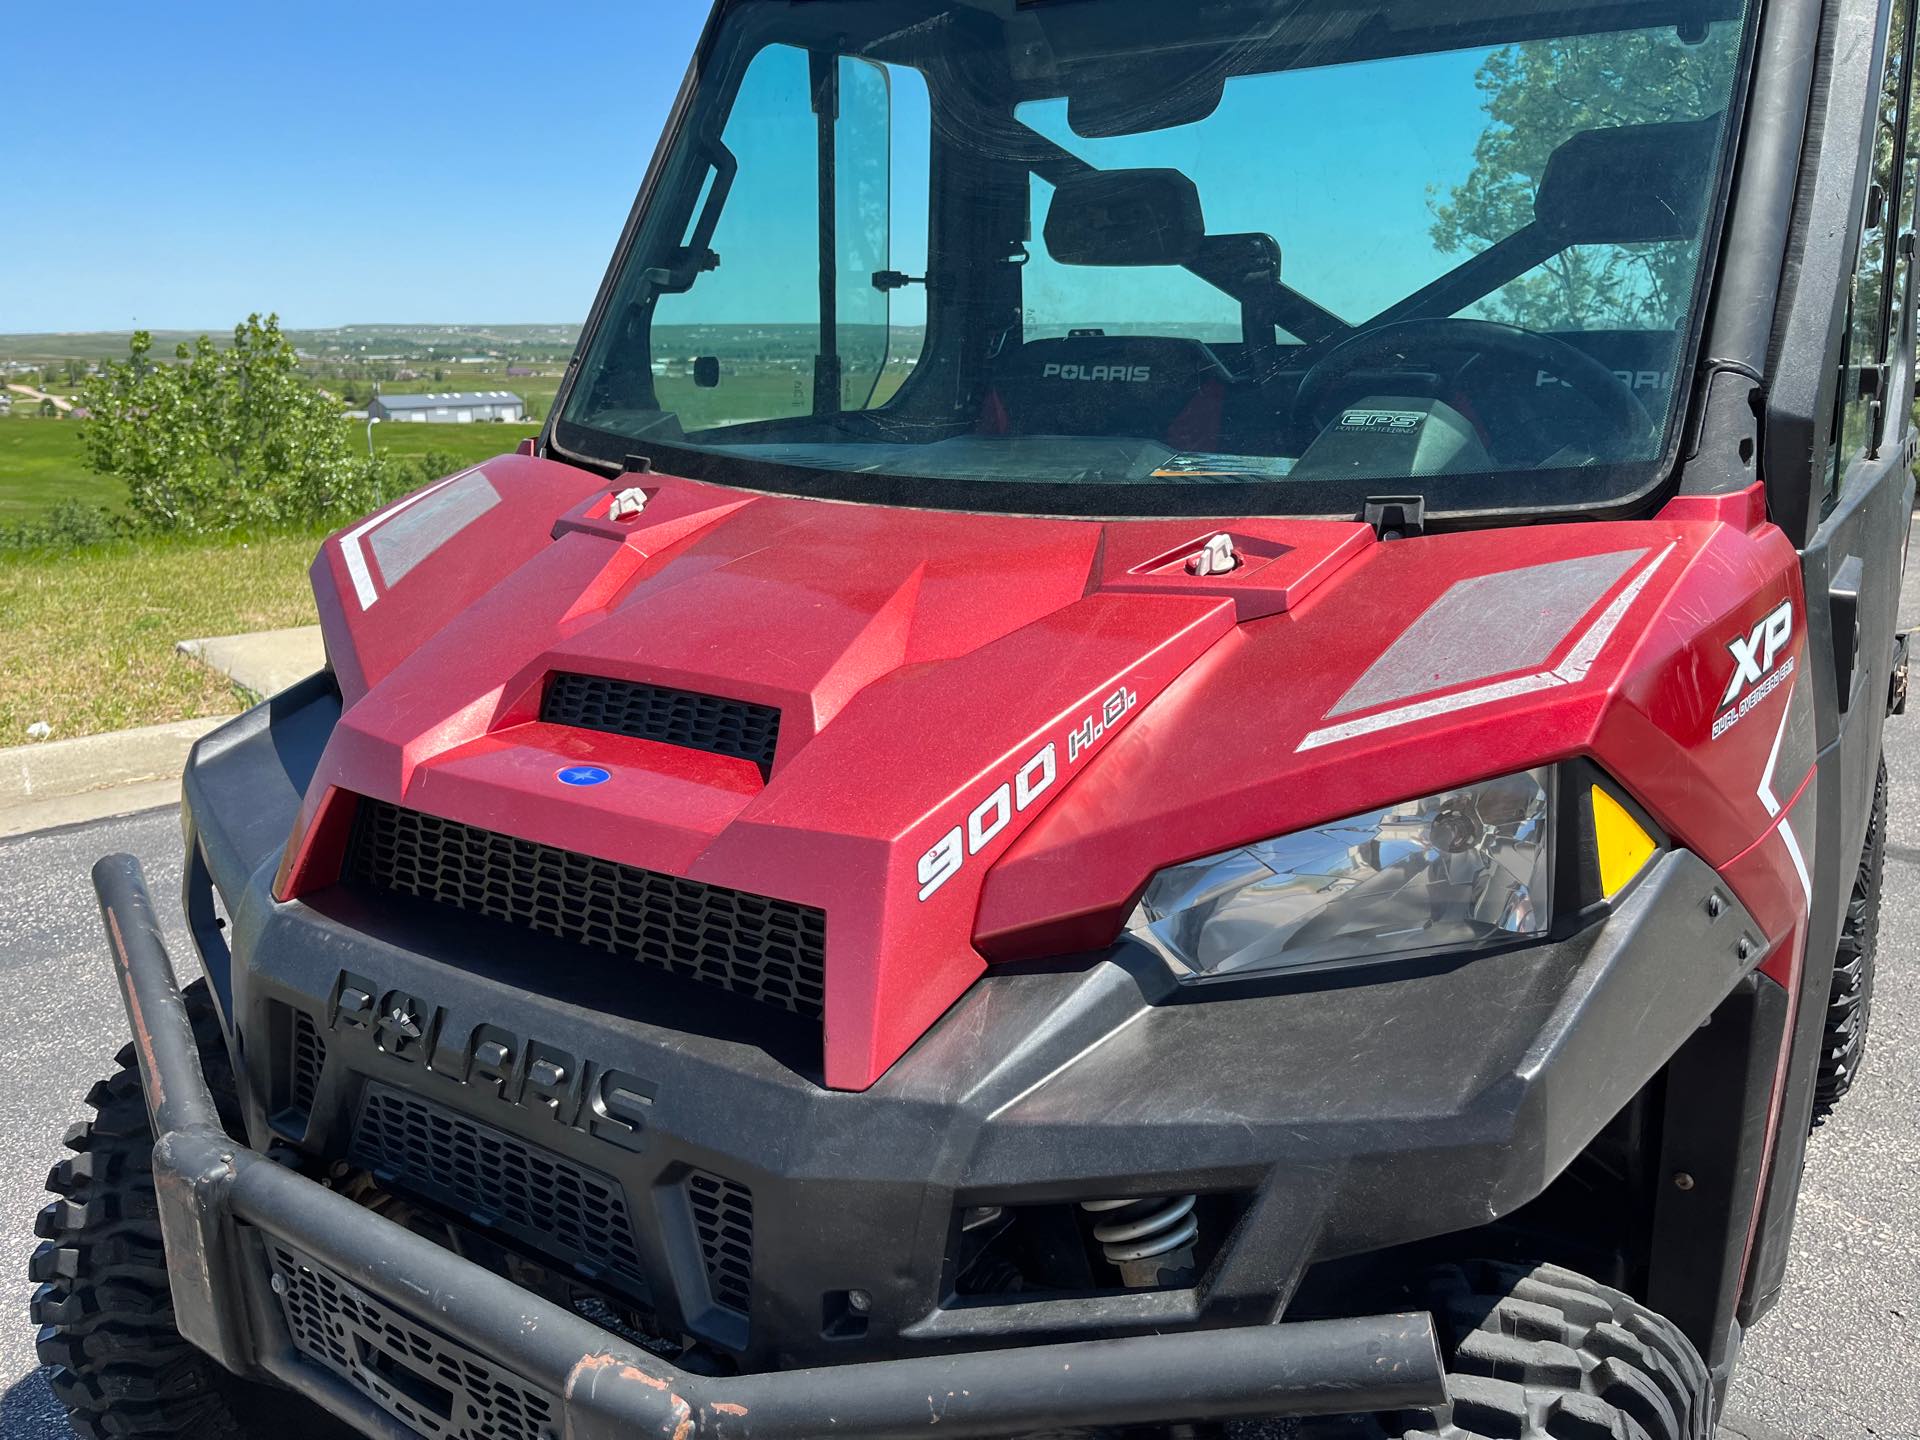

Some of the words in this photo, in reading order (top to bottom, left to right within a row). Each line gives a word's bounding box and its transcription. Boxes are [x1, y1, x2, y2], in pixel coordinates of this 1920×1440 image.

[1042, 363, 1151, 382] POLARIS
[1341, 414, 1419, 427] EPS
[1720, 600, 1793, 707] XP
[1712, 707, 1738, 740] DUAL
[1739, 670, 1779, 717] OVERHEAD
[917, 741, 1056, 902] 900
[327, 968, 659, 1154] POLARIS
